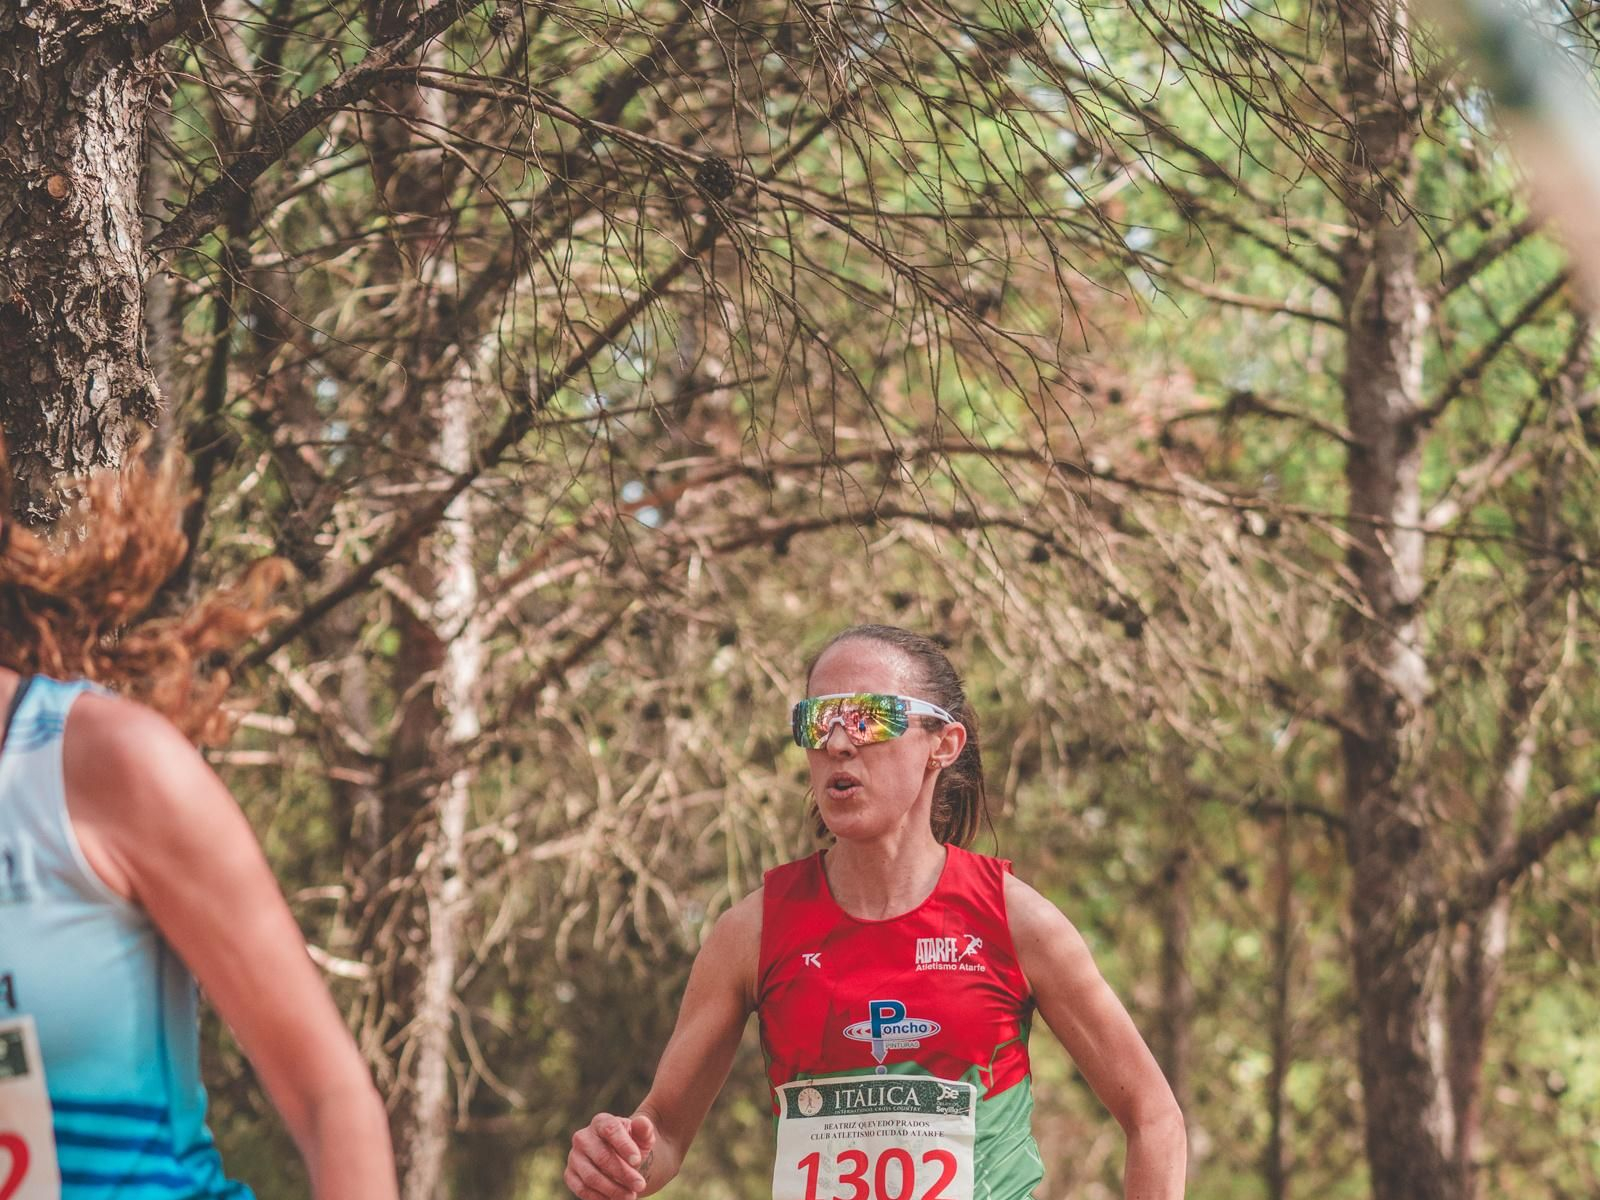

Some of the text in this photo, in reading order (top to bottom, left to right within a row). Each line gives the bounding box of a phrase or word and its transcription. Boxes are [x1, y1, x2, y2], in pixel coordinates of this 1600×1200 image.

[915, 937, 958, 964] ATARFE
[915, 961, 986, 972] Atletismo Atarfe
[870, 1001, 928, 1038] Poncho
[834, 1084, 921, 1109] ITÁLICA
[810, 1128, 945, 1141] CLUB ATLETISMO CIUDAD ATARFE
[824, 1119, 930, 1131] BEATRIZ QUEVEDO PRADOS
